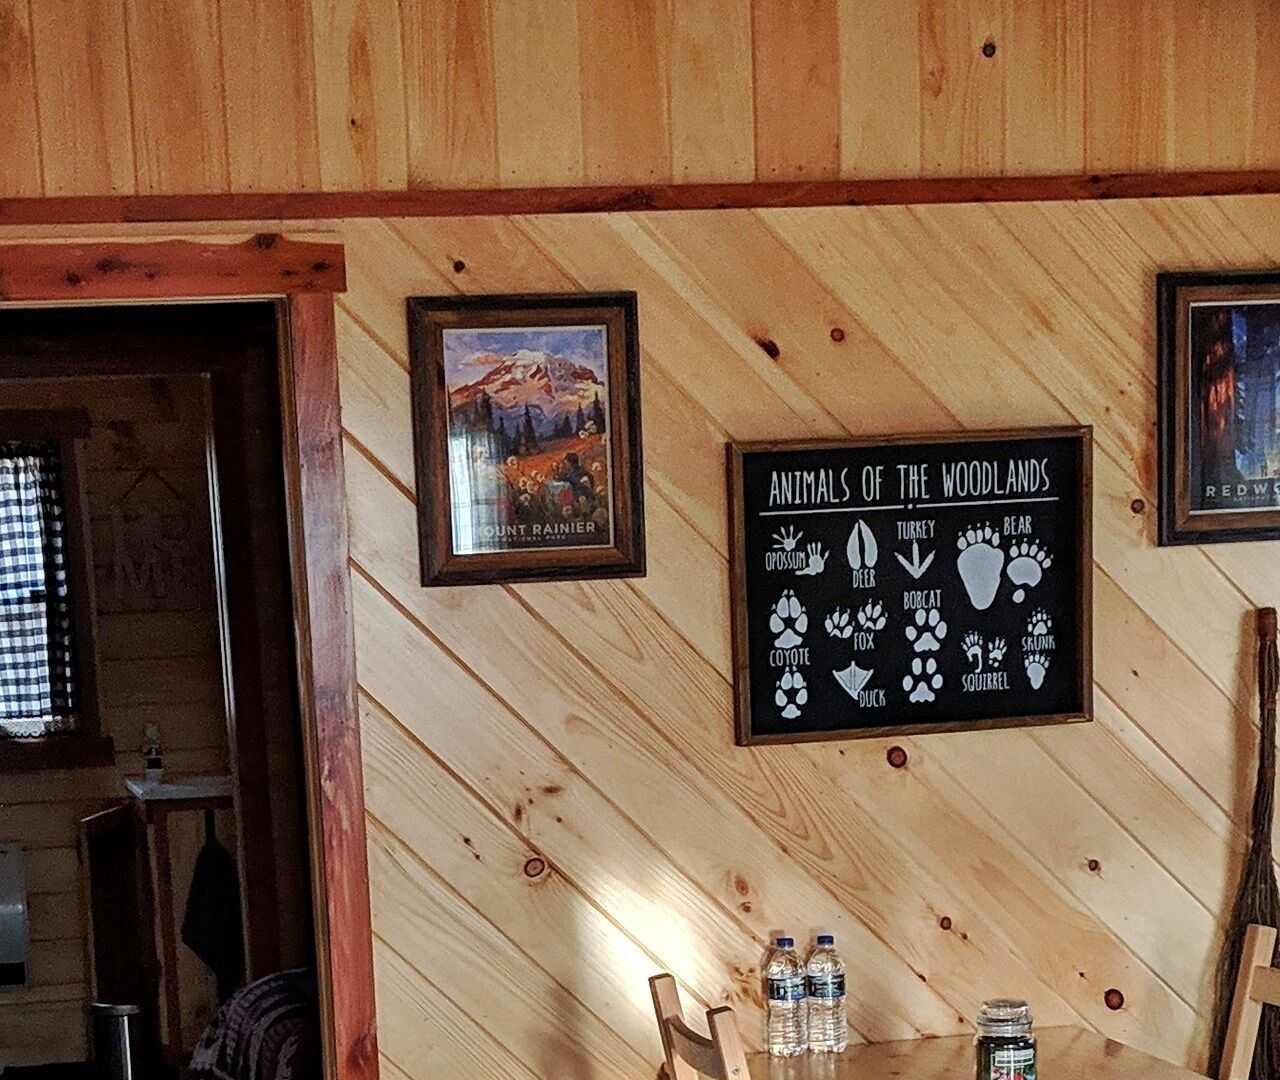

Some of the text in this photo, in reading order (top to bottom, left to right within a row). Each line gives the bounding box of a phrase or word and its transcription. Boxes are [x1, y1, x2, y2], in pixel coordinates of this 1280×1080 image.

[769, 457, 1051, 506] ANIMALS OF THE WOODLANDS
[532, 522, 595, 535] RAINIER
[897, 519, 936, 541] TURKEY
[1003, 515, 1033, 537] BEAR
[765, 550, 806, 571] OPOSSUM
[852, 568, 876, 589] DEER
[903, 588, 942, 611] BOBCAT
[853, 631, 875, 652] FOX
[1021, 634, 1056, 652] SKUNK
[769, 647, 811, 667] COYOTE
[961, 671, 1010, 693] SQUIRREL
[859, 688, 887, 708] DUCK
